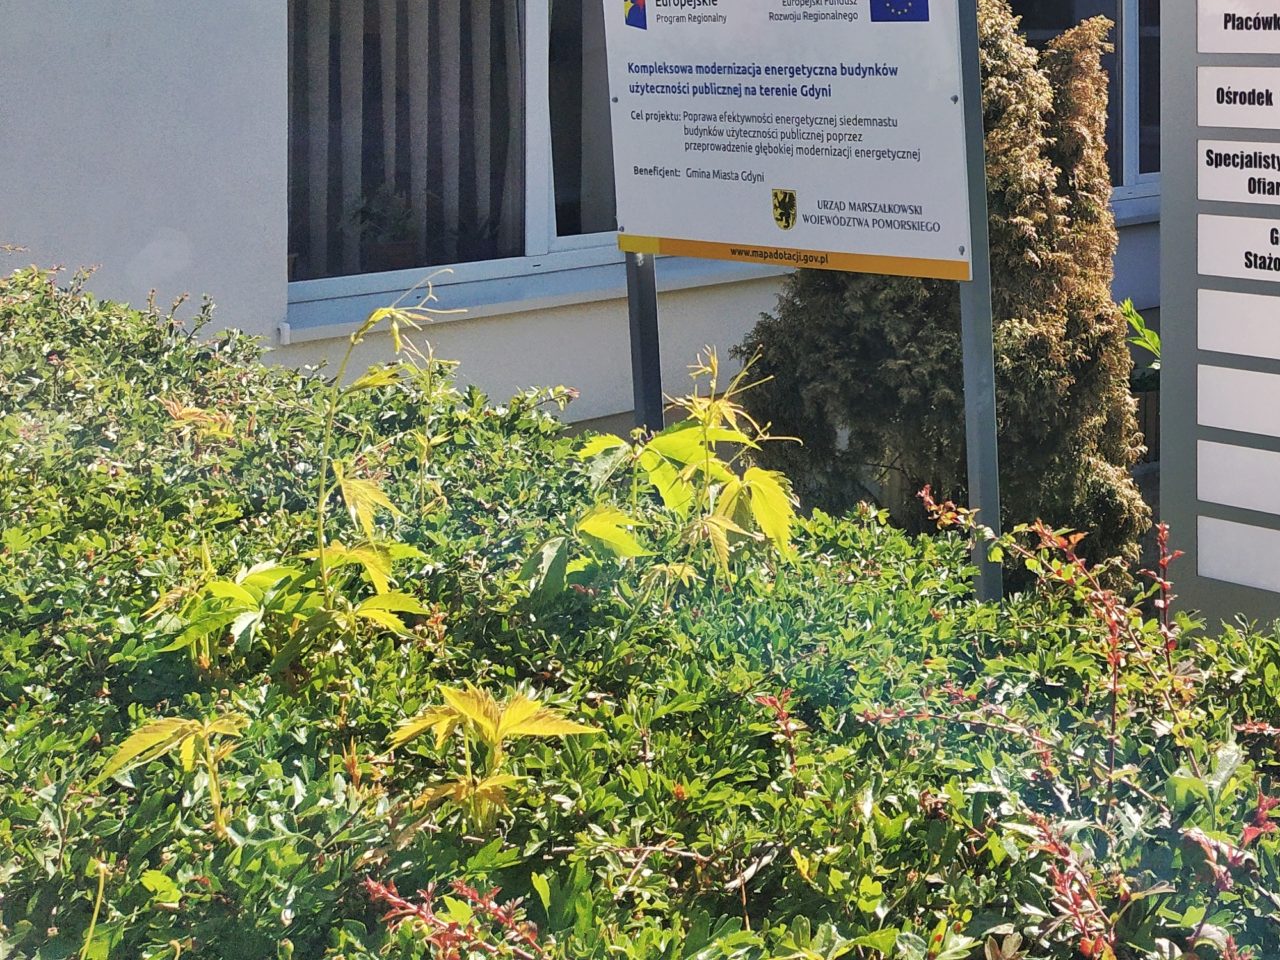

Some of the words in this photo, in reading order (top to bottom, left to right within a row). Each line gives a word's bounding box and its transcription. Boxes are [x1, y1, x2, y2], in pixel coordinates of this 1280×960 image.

[656, 14, 686, 24] Program
[688, 13, 727, 24] Regionalny
[769, 11, 801, 23] Rozwoju
[803, 10, 858, 23] Regionalnego
[628, 62, 693, 76] Kompleksowa
[696, 62, 762, 77] modernizacja
[764, 65, 837, 78] energetyczna
[840, 63, 898, 78] budynków
[629, 82, 690, 96] użyteczności
[692, 83, 742, 98] publicznej
[745, 86, 757, 96] na
[760, 84, 797, 97] terenie
[800, 84, 832, 99] Gdyni
[1216, 88, 1273, 107] Ośrodek
[631, 110, 643, 120] Cel
[645, 111, 681, 122] projektu:
[683, 111, 718, 122] Poprawa
[719, 111, 773, 124] efektywności
[776, 114, 837, 127] energetycznej
[839, 115, 898, 127] siedemnastu
[683, 125, 724, 137] budynków
[726, 127, 778, 139] użyteczności
[780, 129, 824, 143] publicznej
[826, 132, 863, 143] poprzez
[684, 141, 753, 153] przeprowadzenie
[754, 142, 794, 157] głębokiej
[796, 145, 852, 159] modernizacji
[854, 148, 921, 162] energetycznej
[633, 166, 681, 178] Beneficjent:
[685, 168, 711, 178] Gmina
[712, 170, 739, 181] Miasta
[741, 170, 765, 184] Gdyni
[817, 200, 846, 212] URZĄD
[802, 213, 870, 228] WOJEWÓDZTWA
[872, 218, 941, 232] POMORSKIEGO
[730, 247, 829, 265] www.mapadotacji.gov.pl
